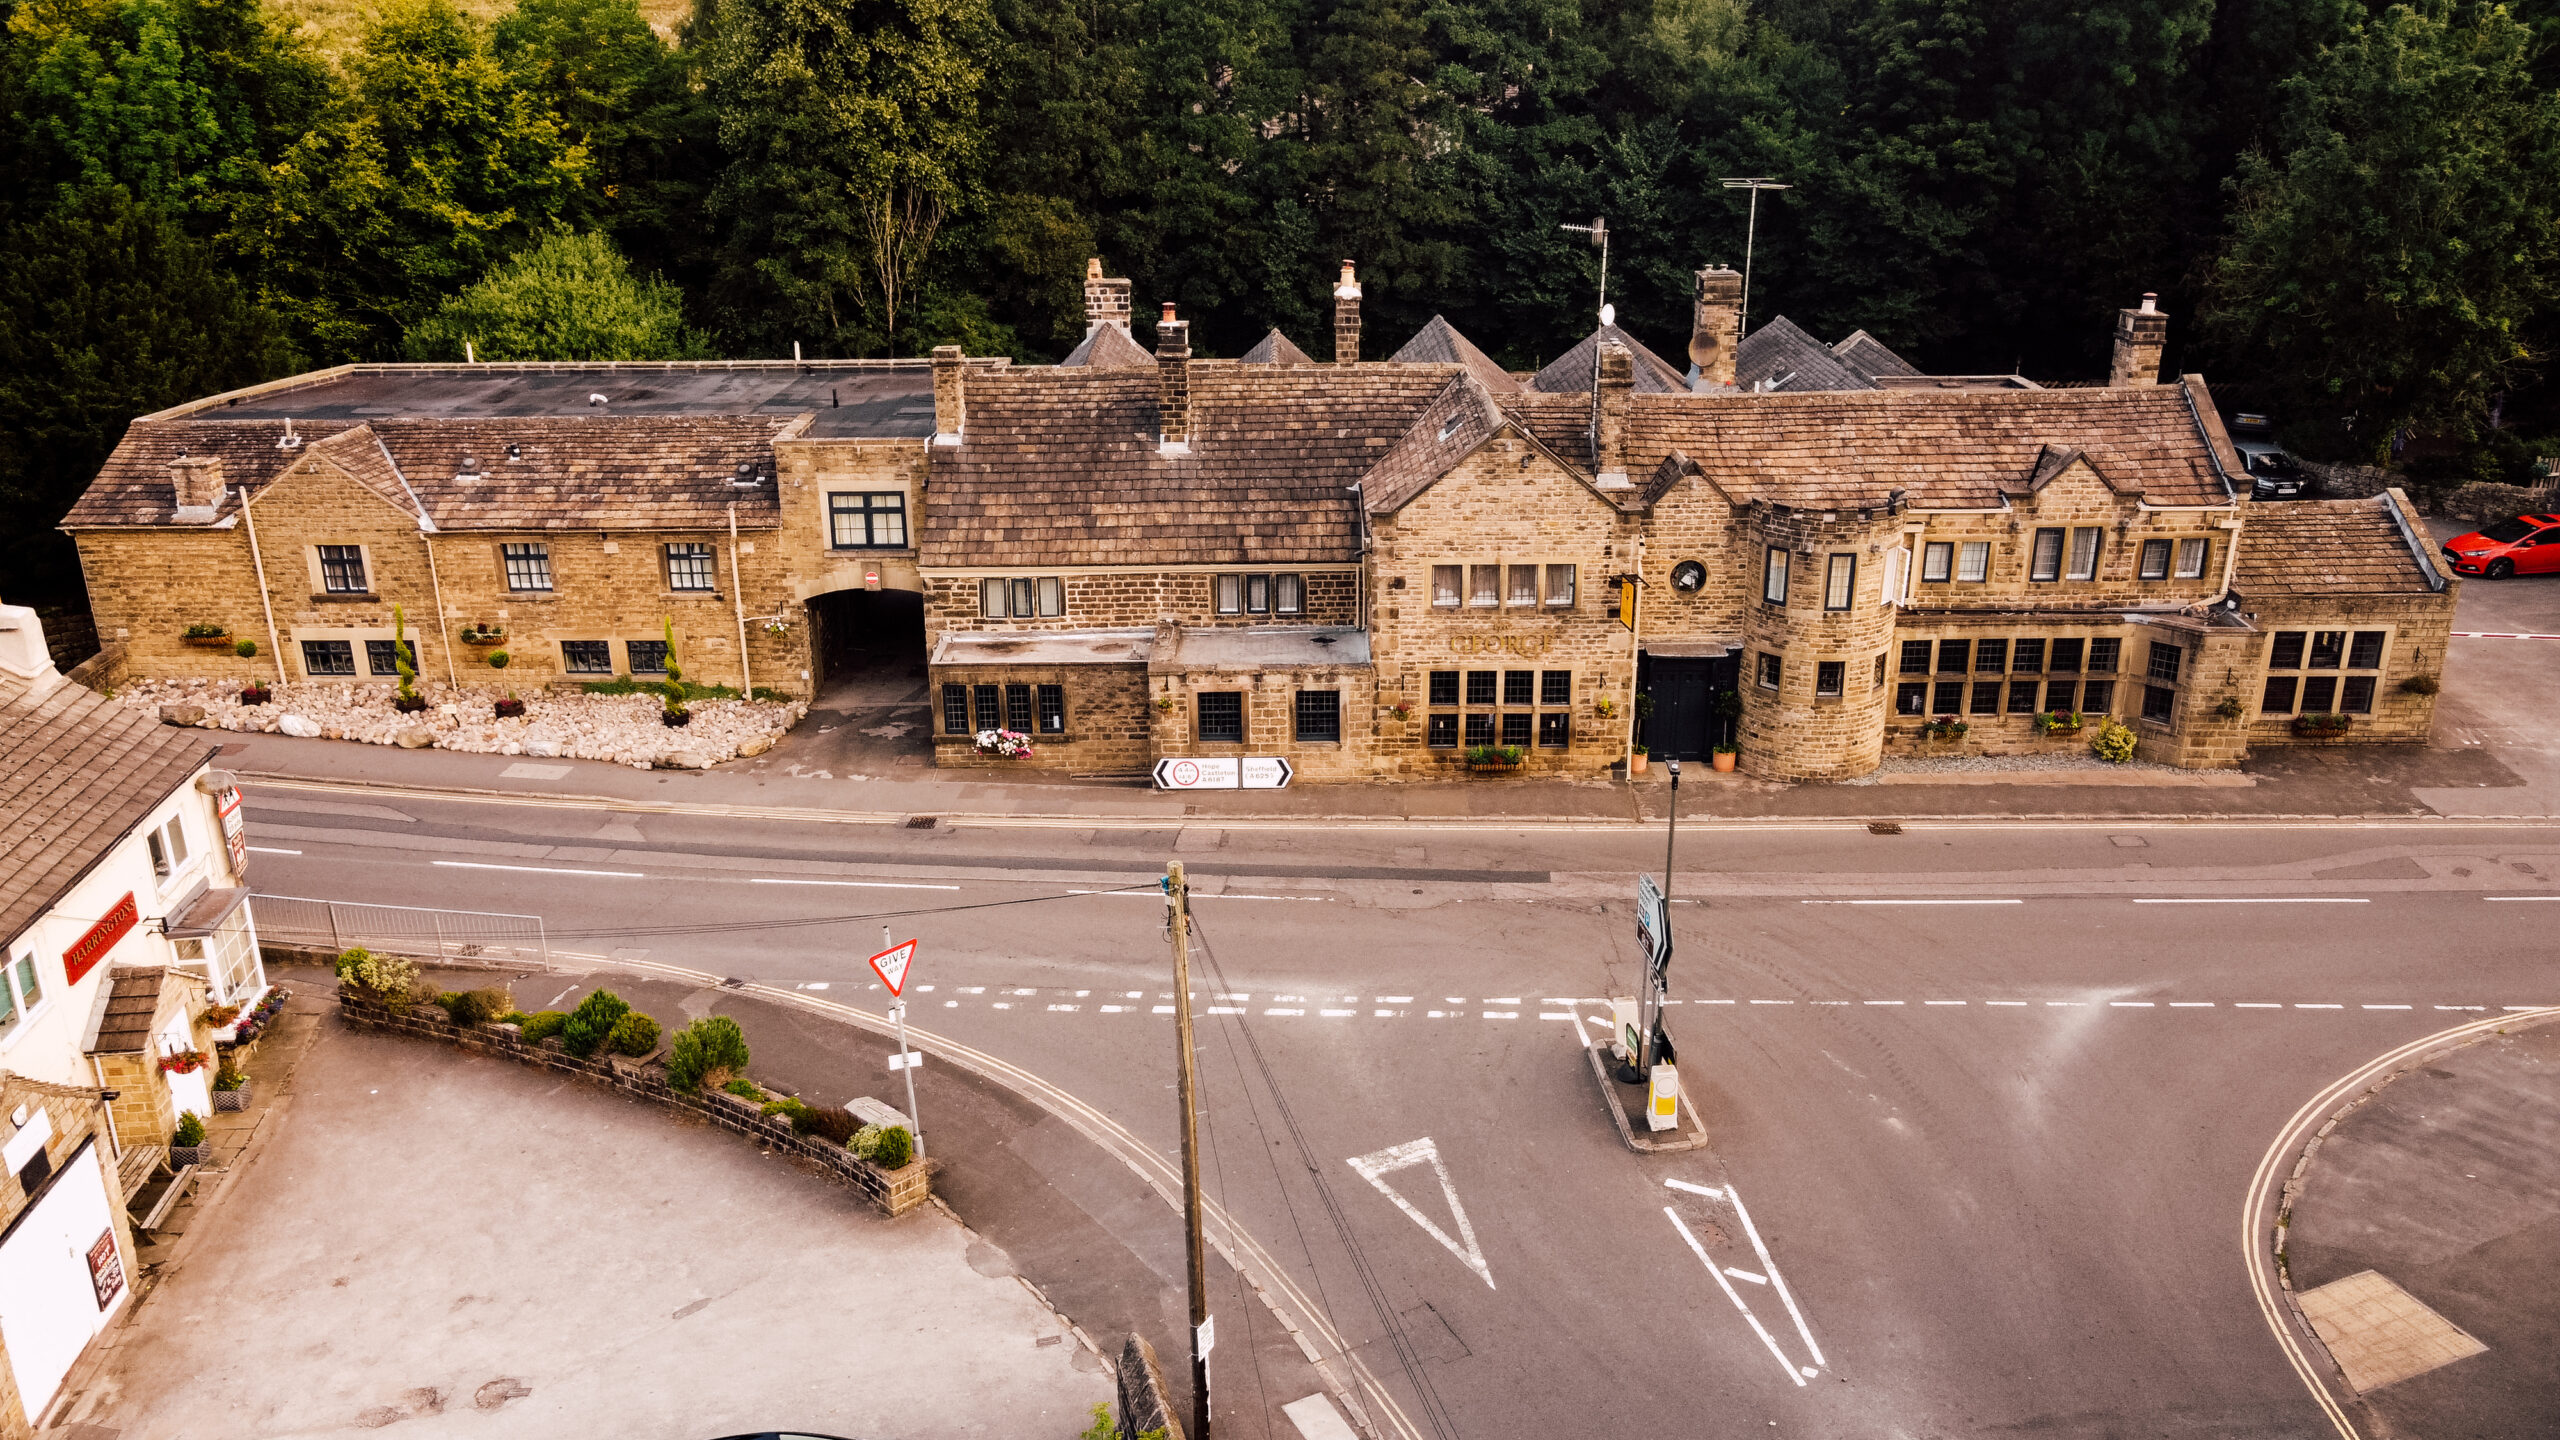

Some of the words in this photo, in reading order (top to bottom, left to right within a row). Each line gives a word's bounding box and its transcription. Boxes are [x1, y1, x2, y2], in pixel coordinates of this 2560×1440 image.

[1450, 633, 1555, 659] GEORGE
[72, 900, 135, 966] HARRINGTONS
[880, 949, 906, 968] GIVE
[888, 963, 903, 975] WAY
